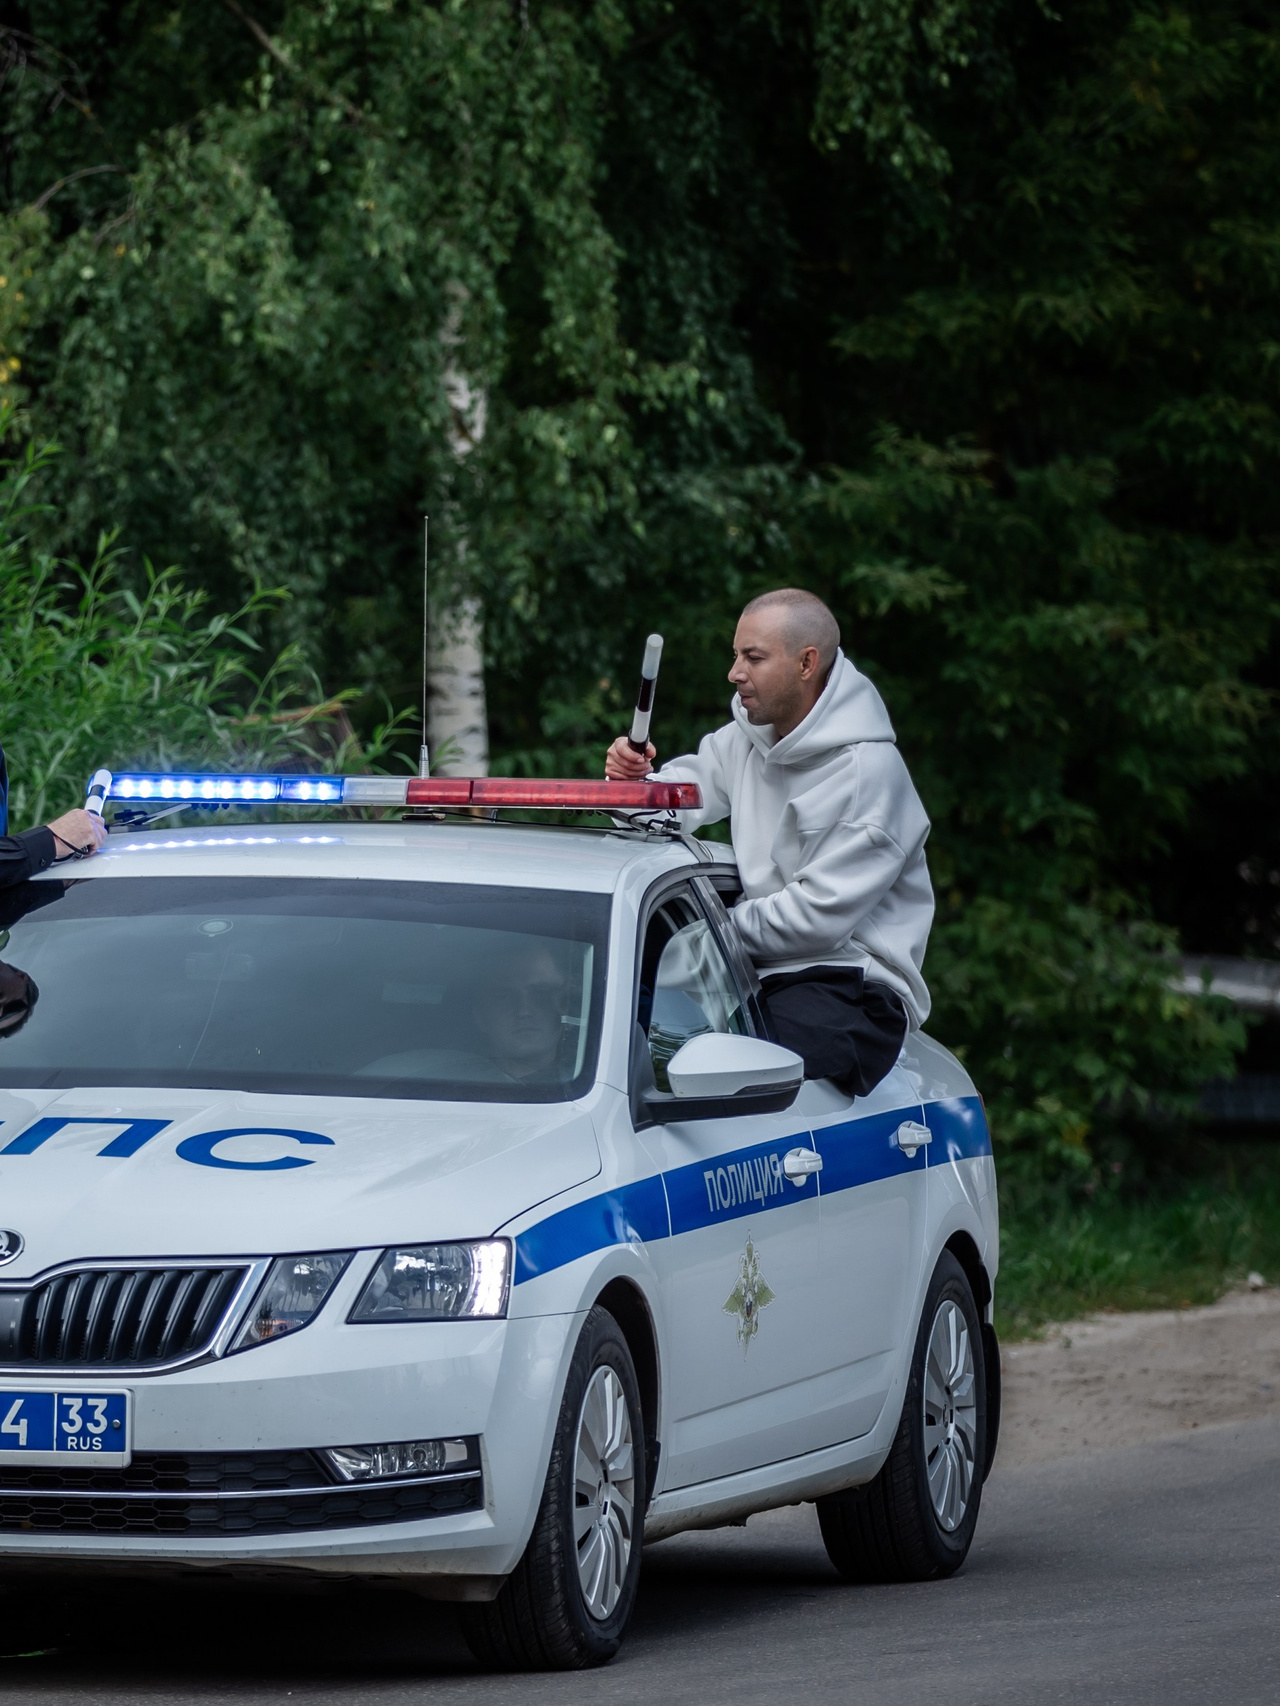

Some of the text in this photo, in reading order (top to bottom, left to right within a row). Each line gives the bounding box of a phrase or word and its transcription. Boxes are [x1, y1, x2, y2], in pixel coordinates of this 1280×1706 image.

[703, 1153, 784, 1212] ПОЛИЦИЯ
[61, 1397, 108, 1435] 33
[67, 1436, 103, 1450] RUS
